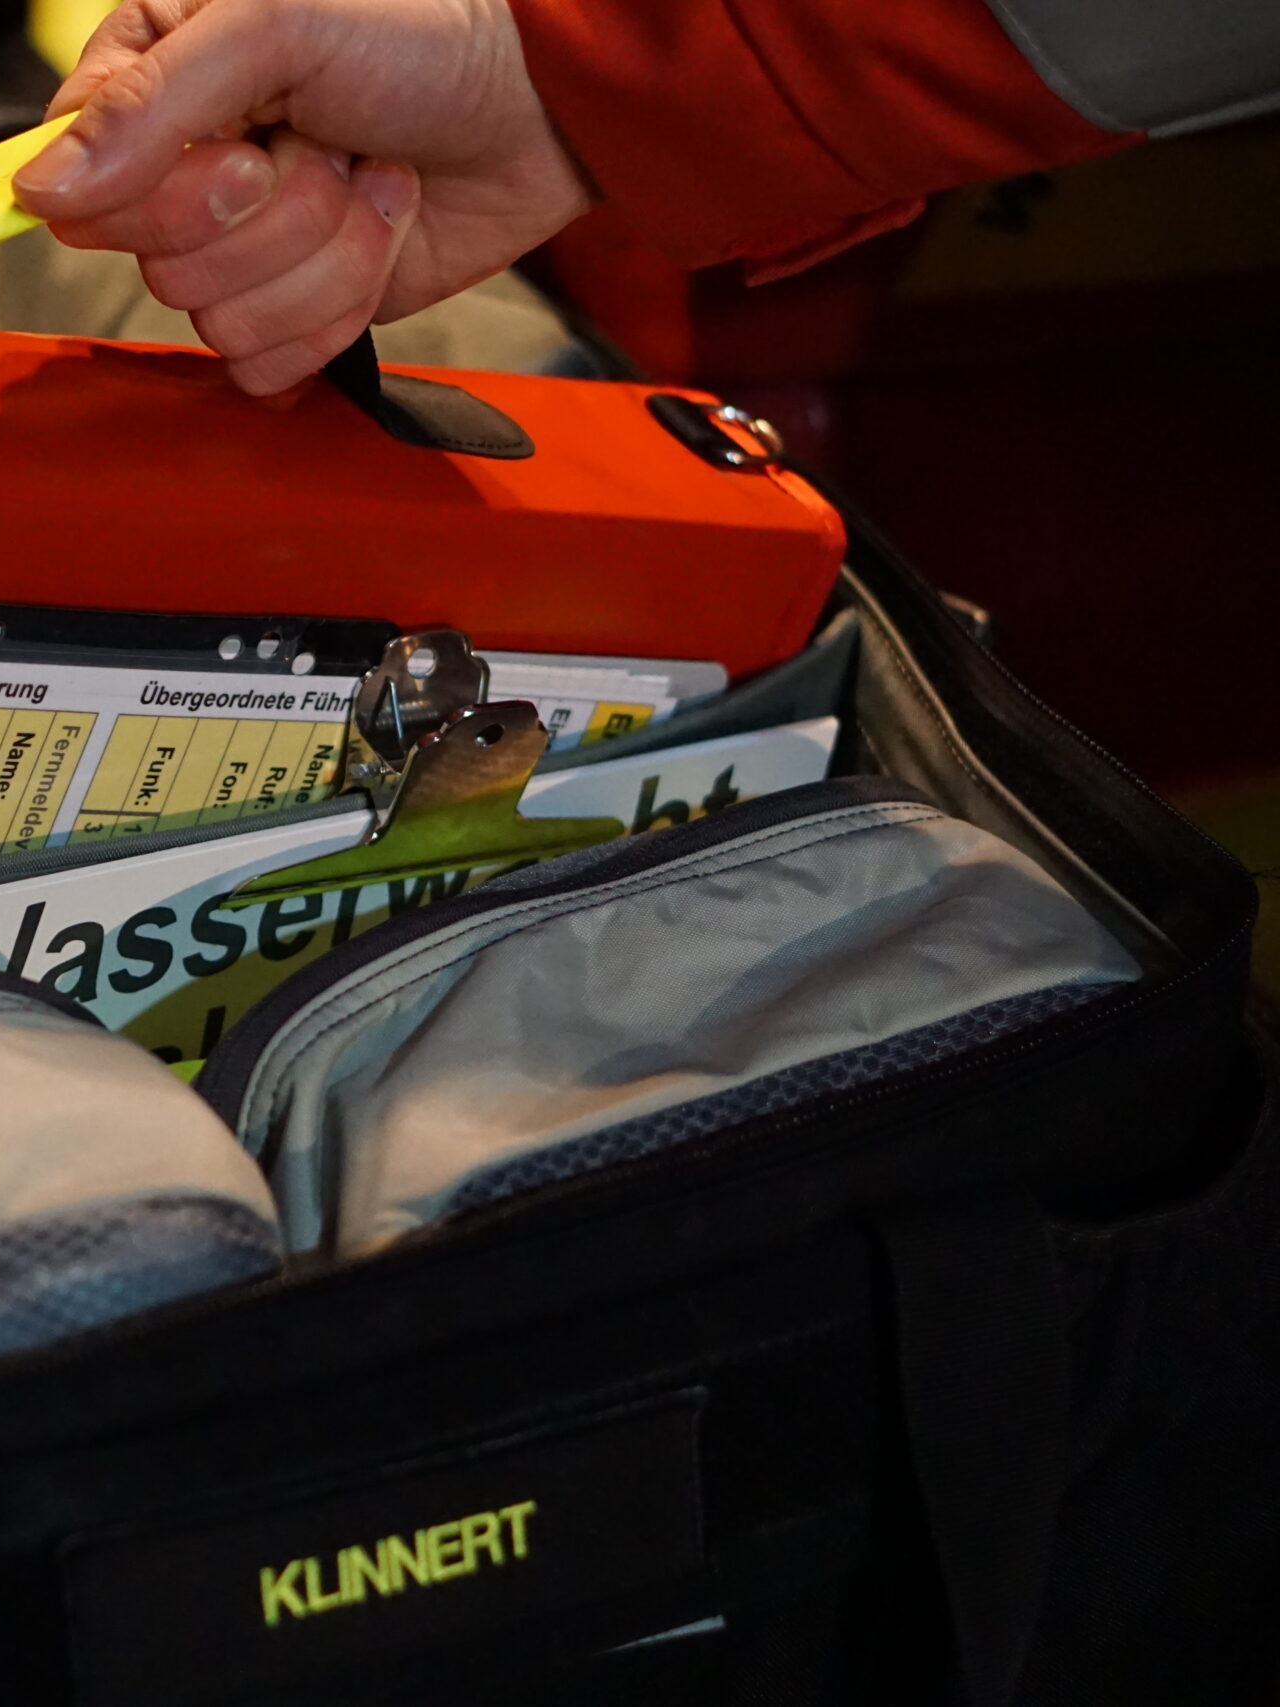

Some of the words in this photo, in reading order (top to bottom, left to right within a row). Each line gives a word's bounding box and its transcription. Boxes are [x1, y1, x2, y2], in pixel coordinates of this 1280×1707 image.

[139, 680, 296, 711] Übergeordnete
[14, 725, 81, 849] Fernmeldev
[134, 746, 176, 806] Funk:
[212, 761, 248, 809] Fon:
[253, 766, 288, 810] Ruf:
[83, 821, 103, 833] 3
[260, 1499, 537, 1627] KLINNERT
